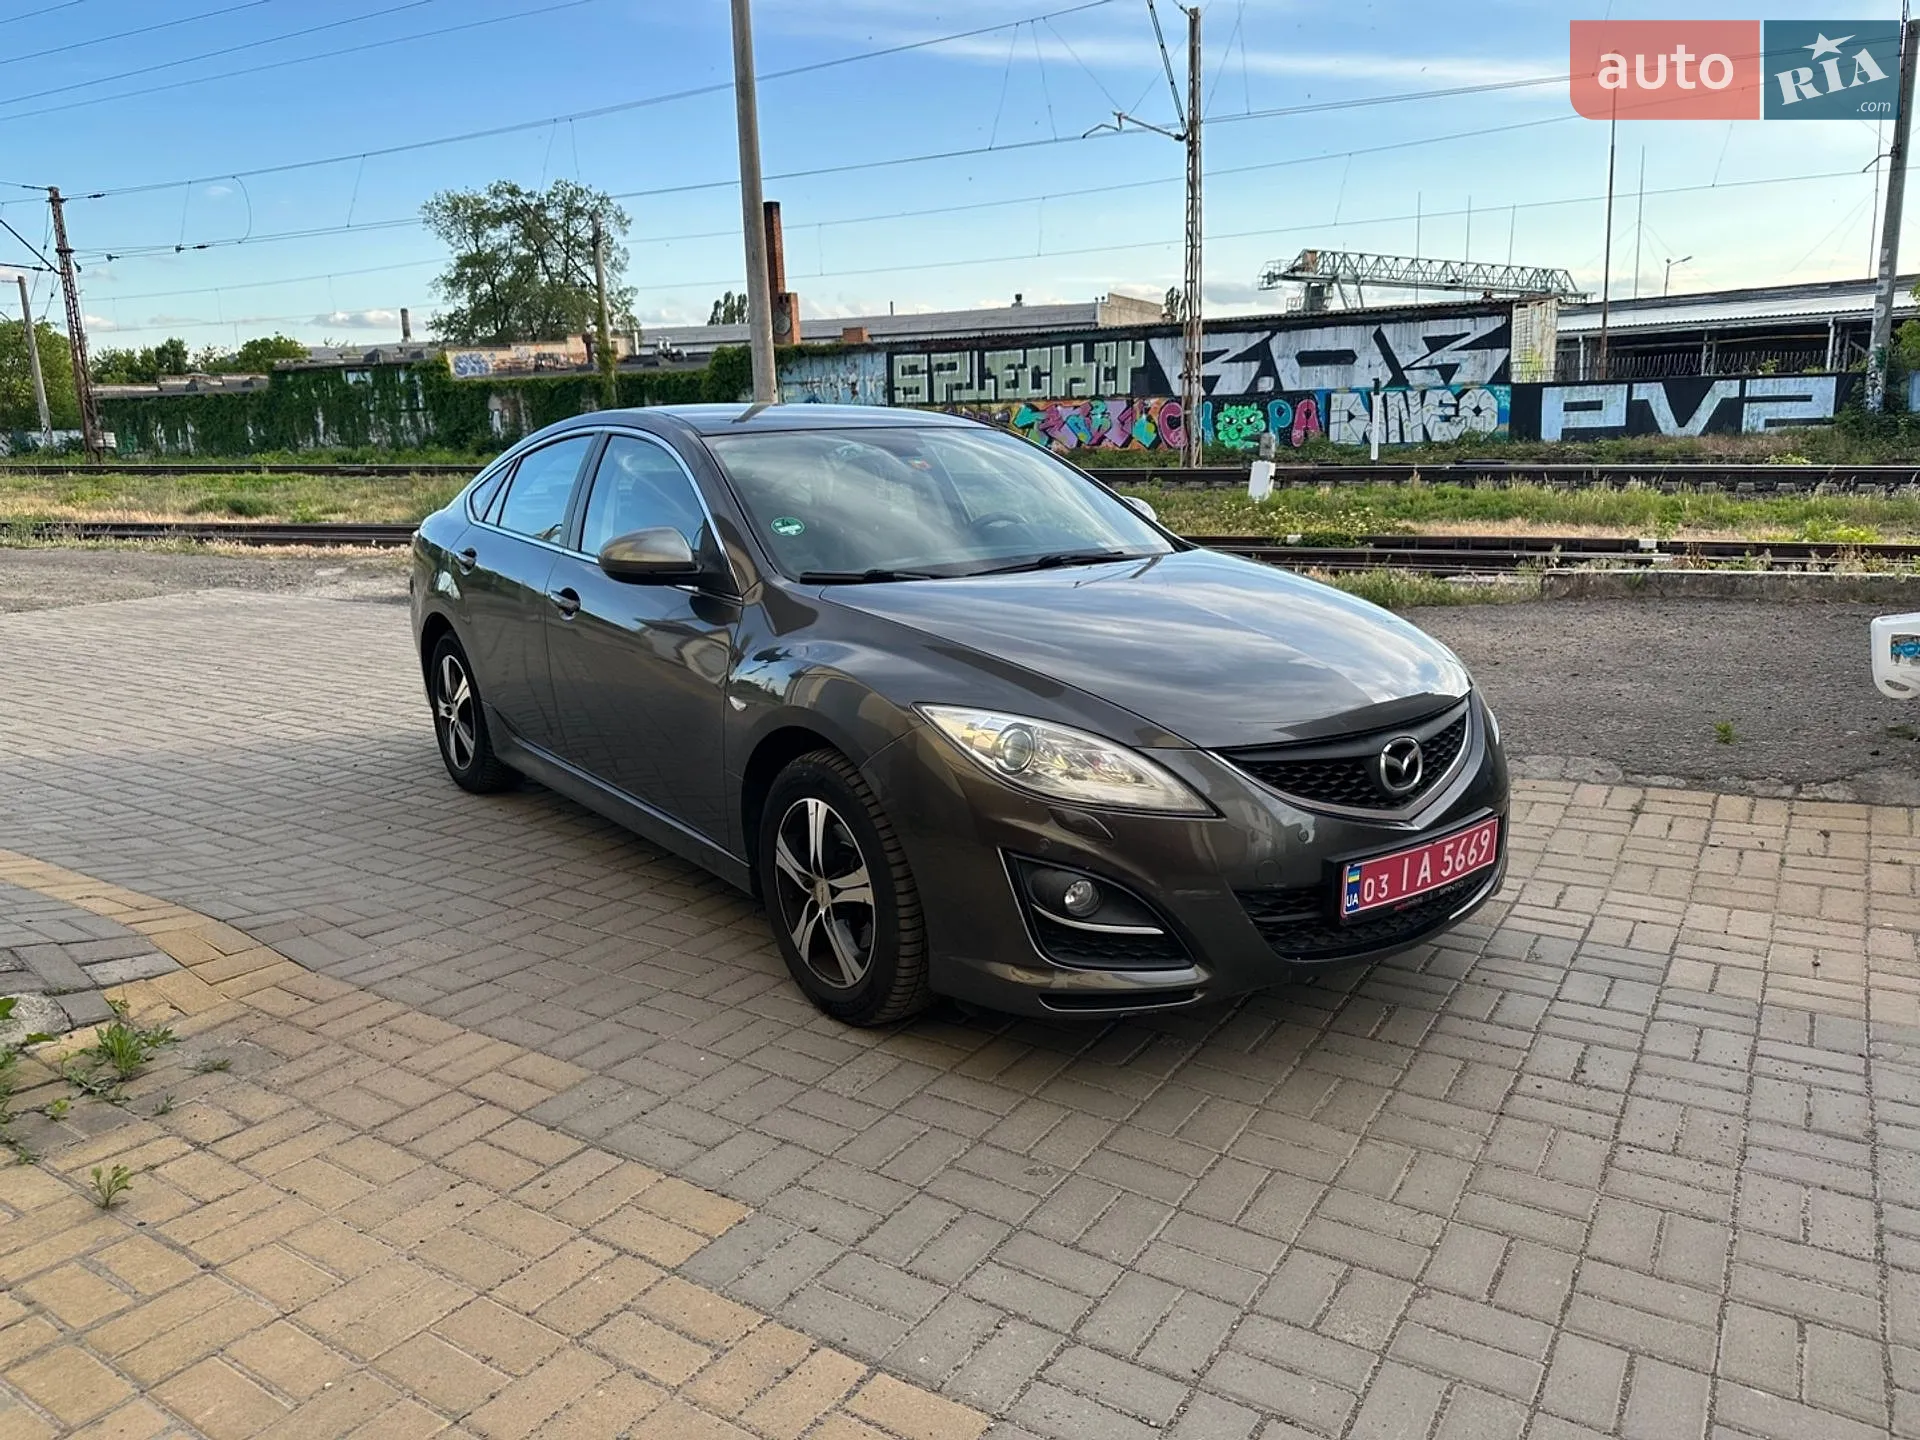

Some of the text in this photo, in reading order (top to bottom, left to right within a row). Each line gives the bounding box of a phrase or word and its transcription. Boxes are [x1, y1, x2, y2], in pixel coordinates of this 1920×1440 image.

[1363, 873, 1390, 902] 03
[1440, 828, 1492, 878] 5669
[1345, 892, 1359, 907] UA
